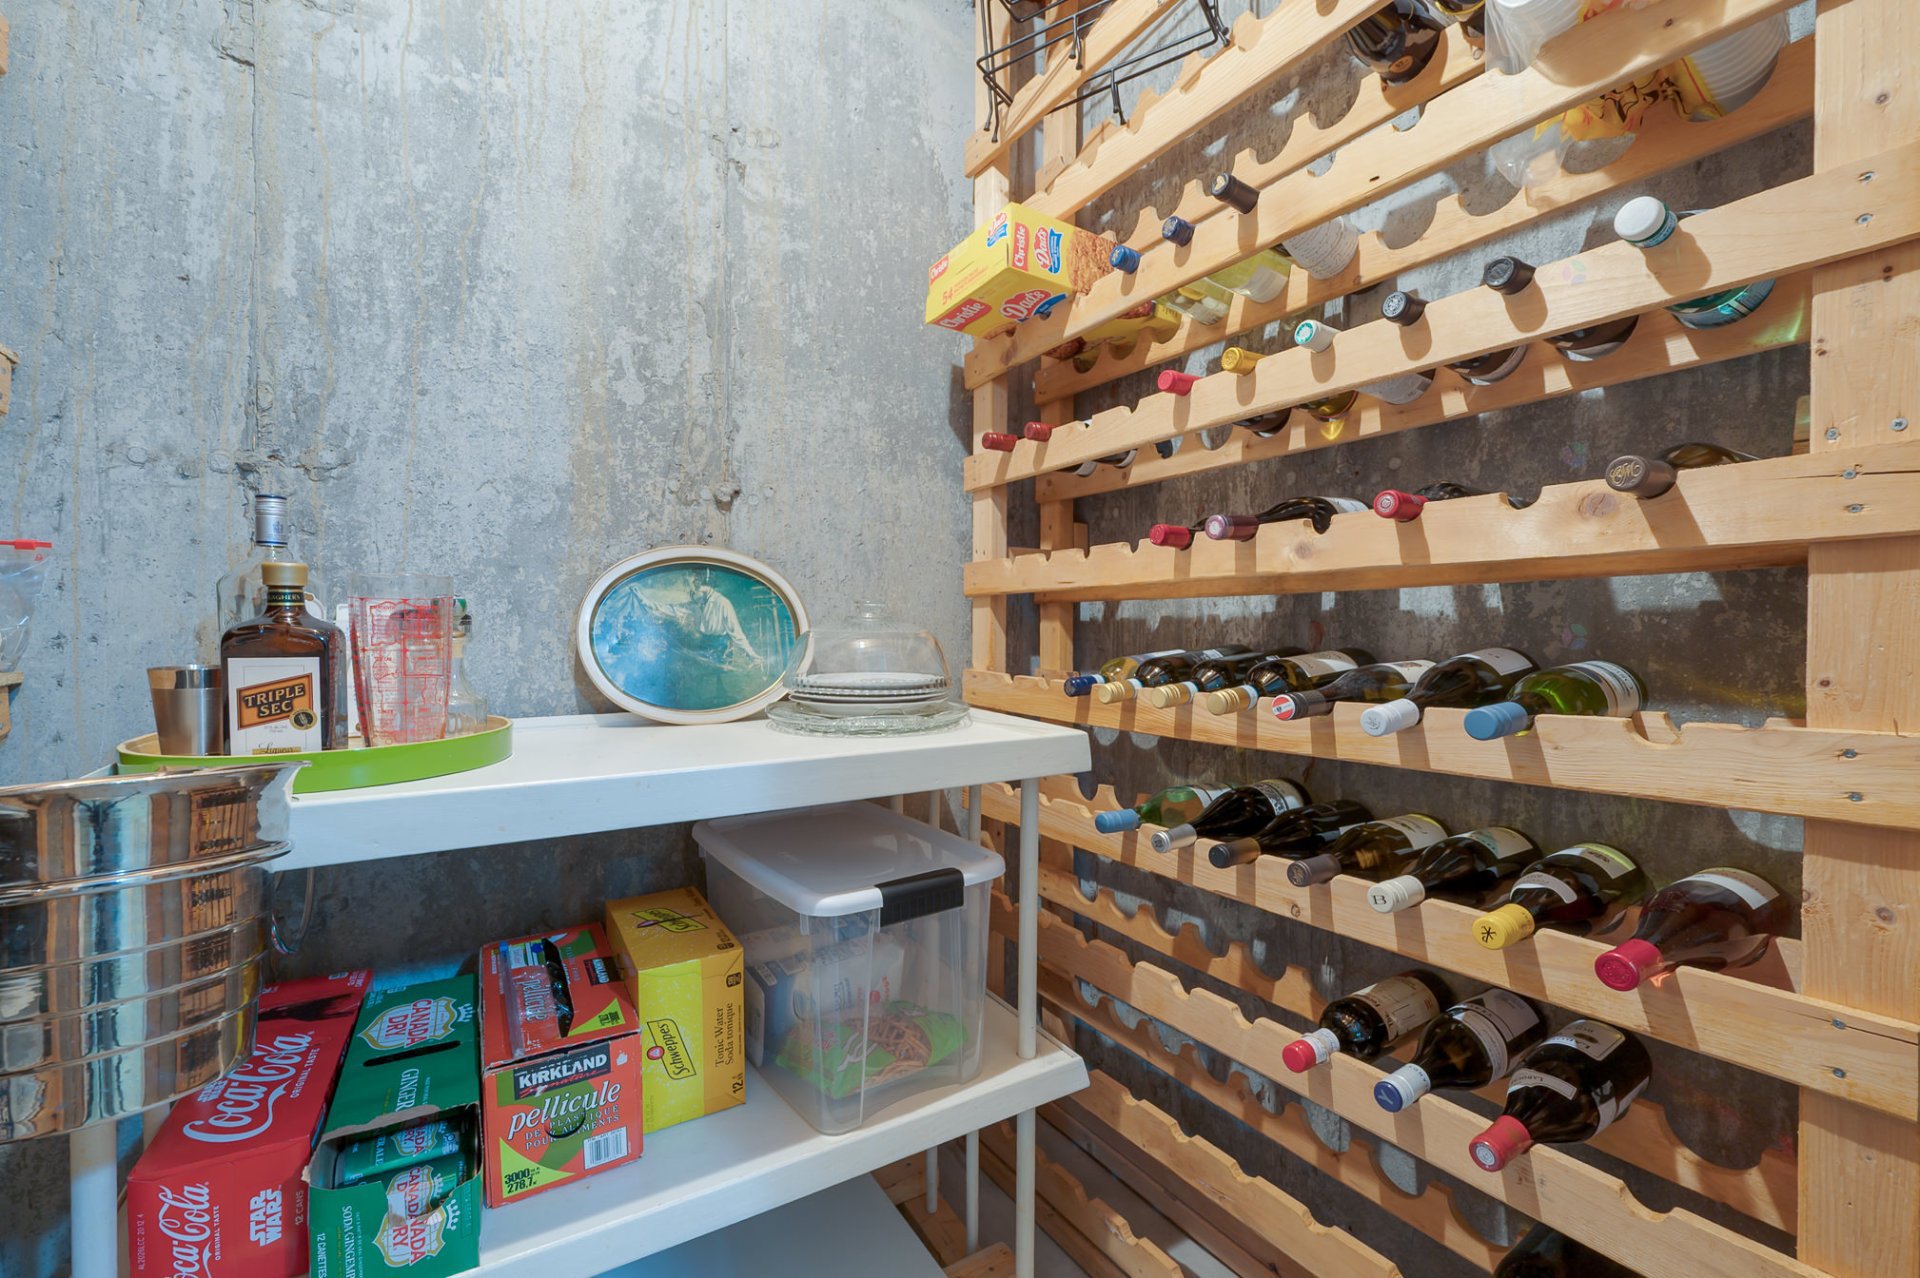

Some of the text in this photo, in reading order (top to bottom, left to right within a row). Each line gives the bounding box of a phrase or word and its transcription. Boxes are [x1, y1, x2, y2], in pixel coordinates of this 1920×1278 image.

[1014, 225, 1026, 267] Christie
[1035, 228, 1049, 267] Dad's
[940, 302, 986, 327] Christie
[1000, 289, 1046, 320] Dad's
[243, 683, 306, 709] TRIPLE
[259, 700, 294, 718] SEC
[385, 1013, 409, 1037] DRY
[406, 999, 433, 1047] CANADA
[715, 1007, 724, 1067] Tonic Water
[725, 1003, 735, 1065] Soda tonique
[659, 1023, 690, 1076] Schweppes
[183, 1034, 314, 1143] Coca-Cola
[290, 1047, 320, 1099] ORIGINAL TASTE
[395, 1068, 419, 1112] GINGER
[519, 1054, 608, 1089] KIRKLAND
[732, 1080, 744, 1094] 12
[507, 1080, 622, 1140] pellicule
[525, 1129, 542, 1141] DE
[504, 1167, 530, 1185] 3000
[507, 1178, 533, 1194] 278.7
[250, 1190, 267, 1246] STAR
[264, 1188, 283, 1245] WARS
[294, 1190, 304, 1226] 12 CANS
[342, 1205, 352, 1234] SODA
[158, 1182, 212, 1278] oca-Cola
[213, 1205, 222, 1261] ORIGINAL TASTE
[317, 1233, 326, 1242] 12
[393, 1224, 409, 1249] RY
[409, 1217, 427, 1264] NADA
